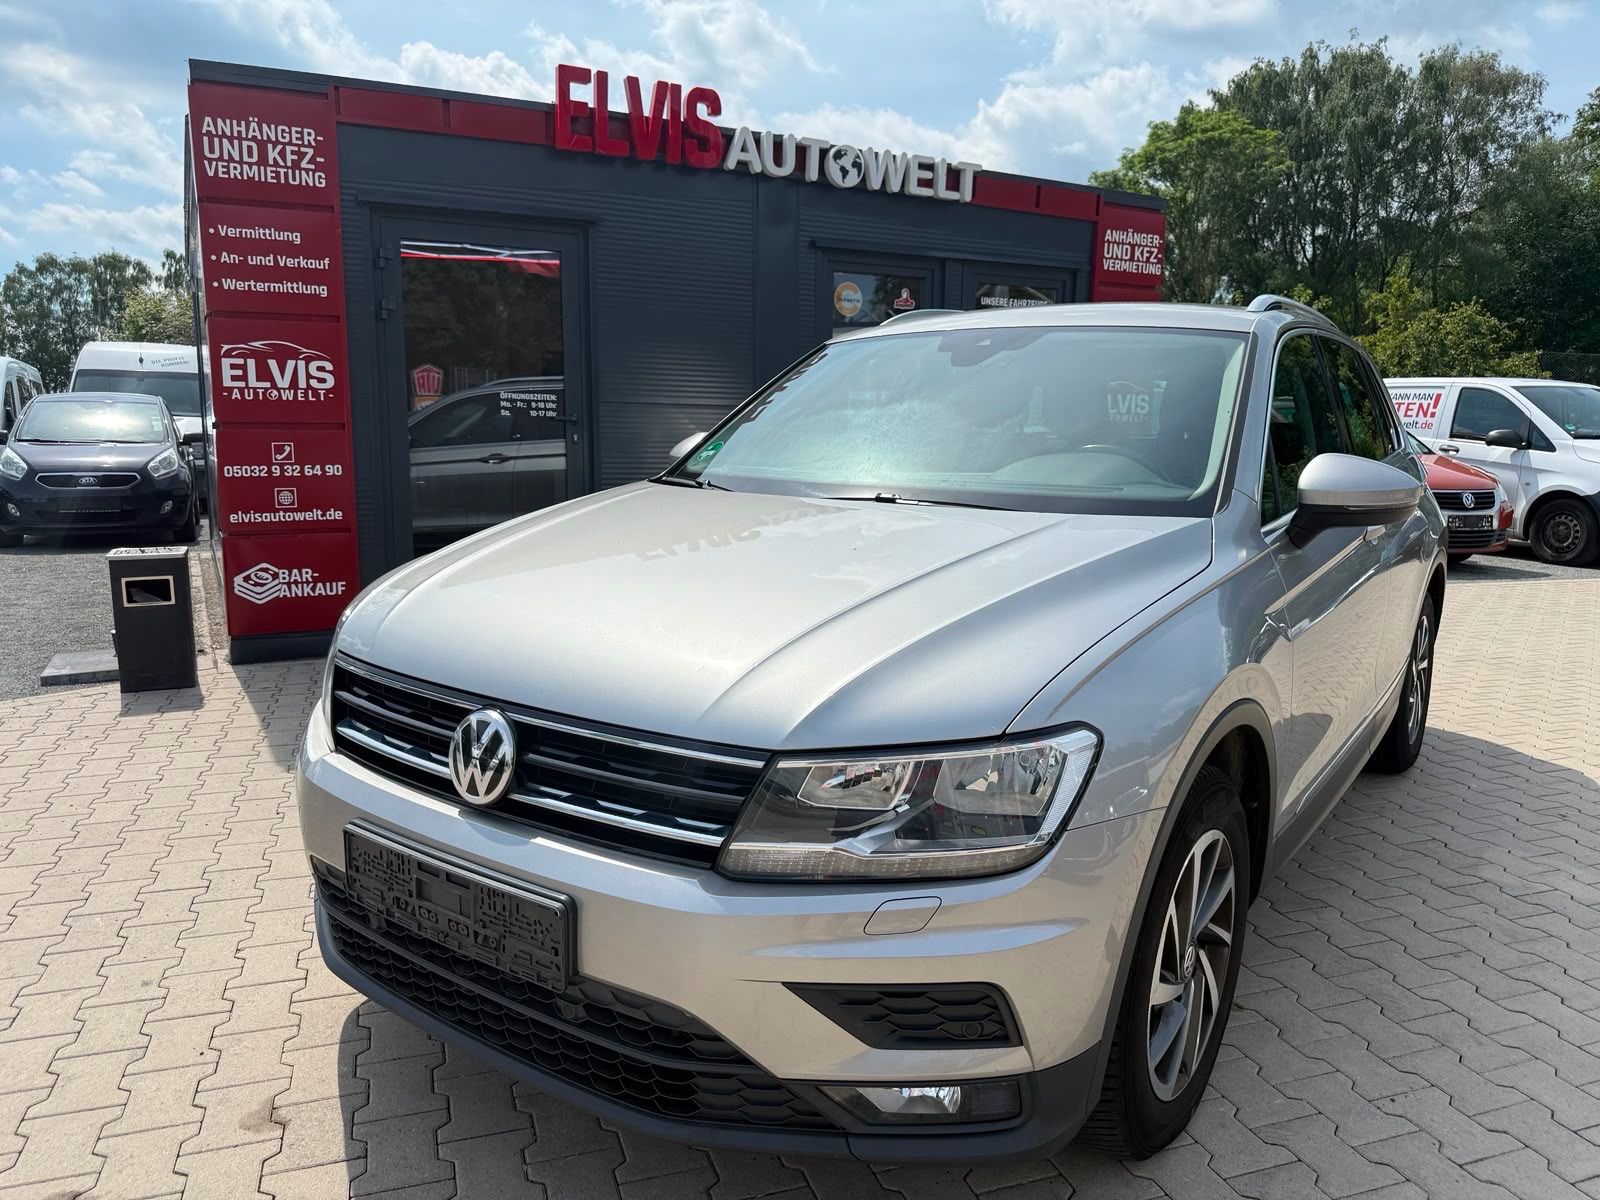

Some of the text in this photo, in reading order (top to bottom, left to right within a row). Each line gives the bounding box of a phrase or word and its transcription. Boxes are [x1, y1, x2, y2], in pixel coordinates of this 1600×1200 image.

[201, 116, 324, 146] ANHÄNGER-
[554, 63, 983, 203] ELVIS AUTOWELT
[203, 136, 325, 170] UND KFZ-
[204, 159, 326, 188] VERMIETUNG
[218, 224, 301, 244] Vermittlung
[1104, 228, 1163, 248] ANHÄNGER-
[220, 251, 330, 270] An- und Verkauf
[1104, 242, 1162, 263] UND KFZ-
[1103, 258, 1162, 276] VERMIETUNG
[222, 278, 328, 298] Wertermittlung
[980, 296, 1008, 307] UNSERE
[221, 357, 335, 389] ELVIS
[1412, 392, 1435, 401] MAN
[224, 464, 343, 477] 05032 9 32 64 90
[229, 508, 343, 524] elvisautowelt.de
[278, 568, 319, 583] BAR-
[279, 581, 347, 598] ANKAUF
